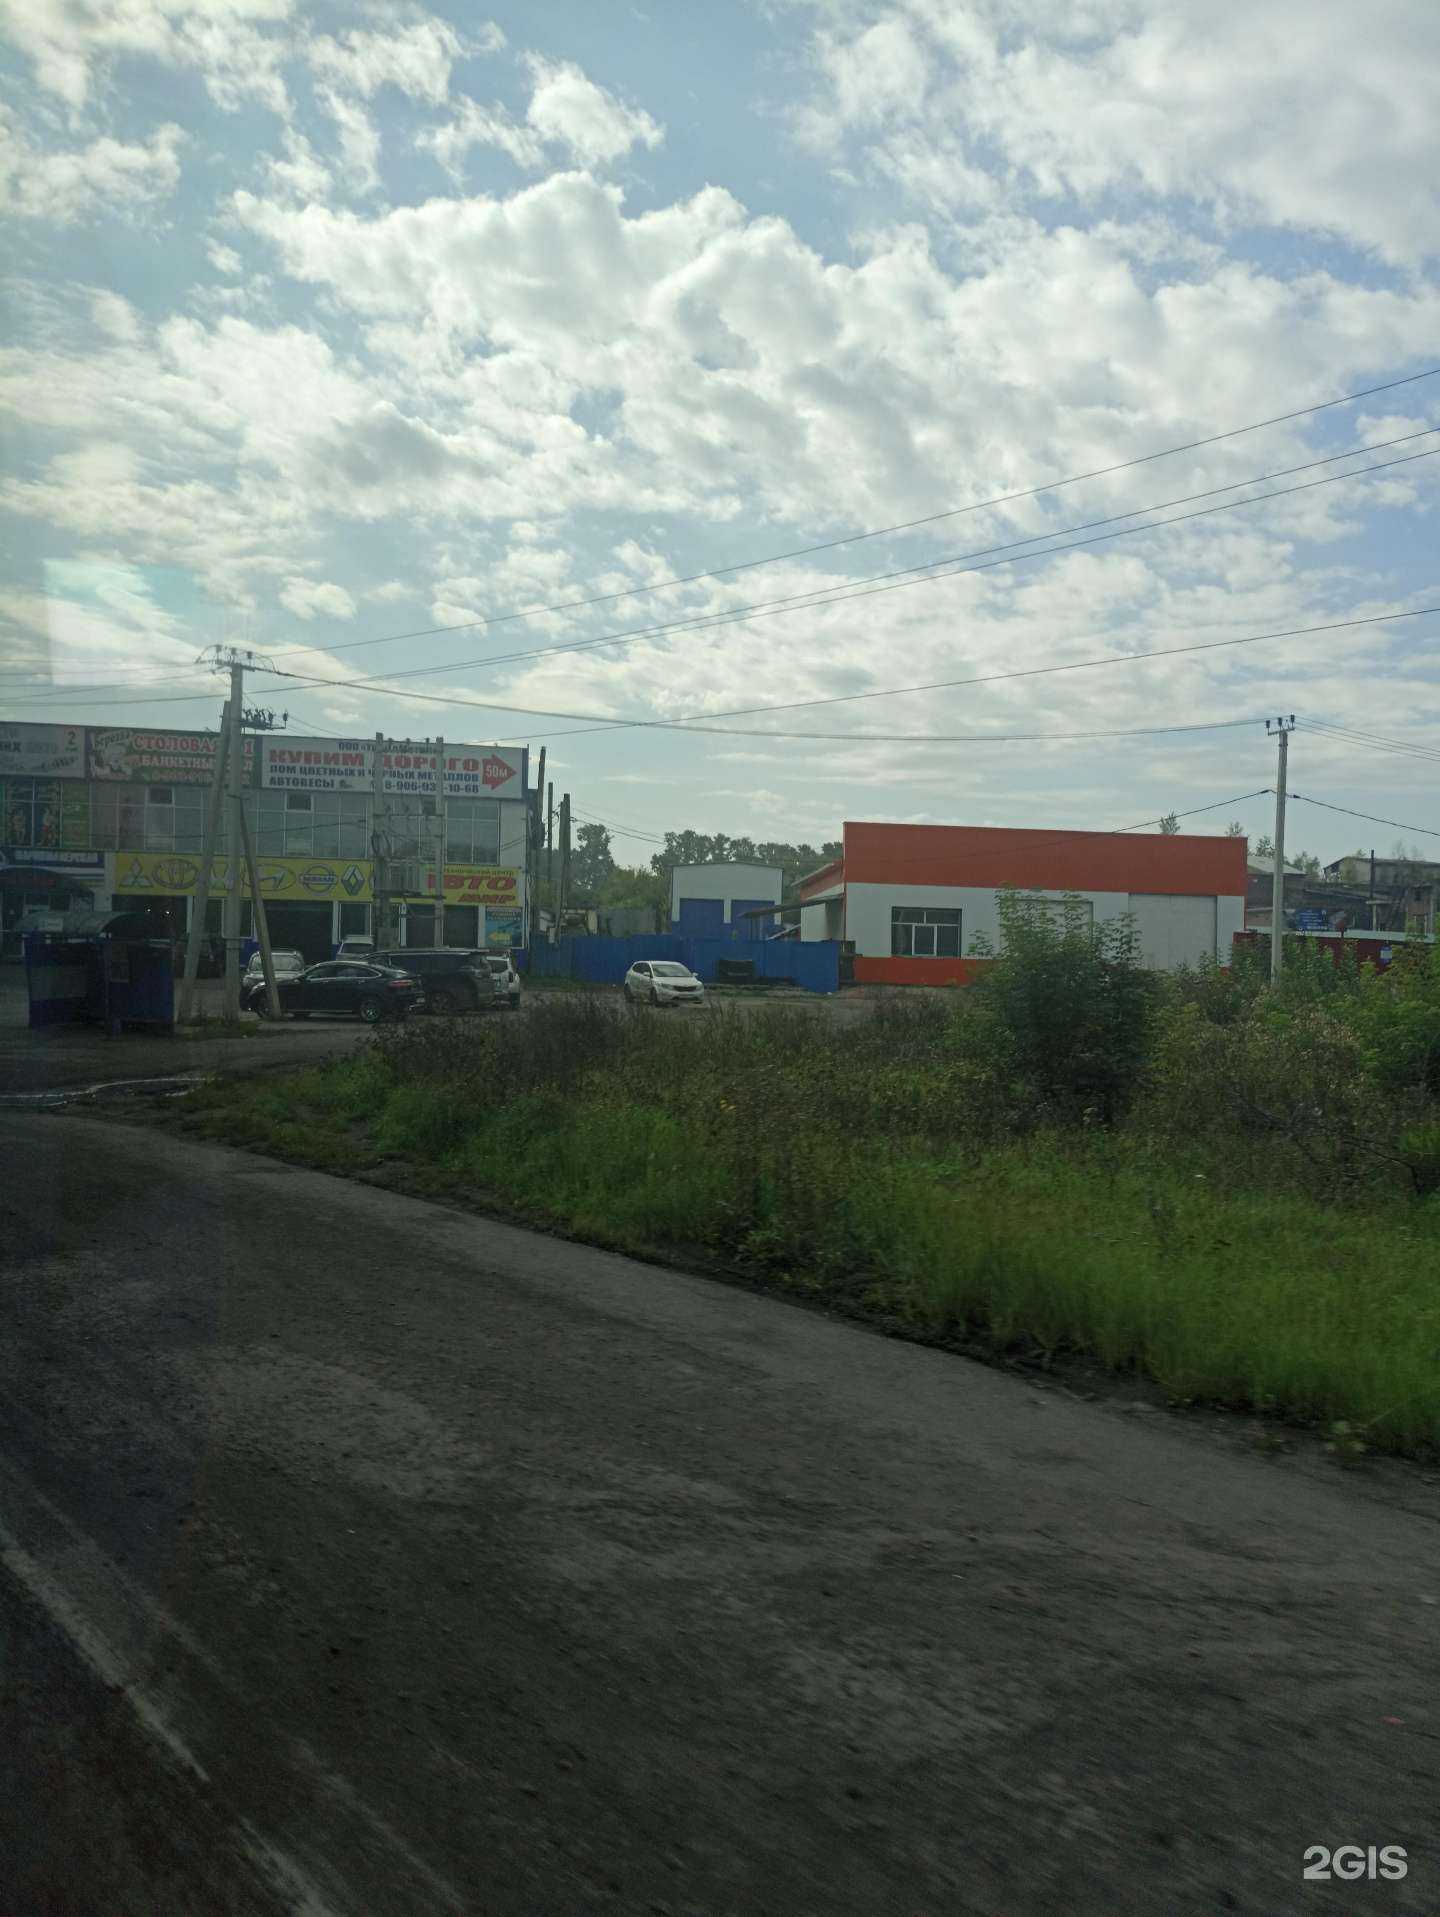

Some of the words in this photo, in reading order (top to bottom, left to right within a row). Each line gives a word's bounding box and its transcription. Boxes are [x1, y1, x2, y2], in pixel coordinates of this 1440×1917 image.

[133, 735, 217, 753] СТОЛОВА
[269, 750, 364, 767] КУПИМ
[372, 752, 479, 771] ОРОГО
[299, 766, 353, 777] ЦВЕТНЫХ
[367, 769, 415, 779] ЧРНЫХ
[269, 776, 334, 788] АВТОВЕСЫ
